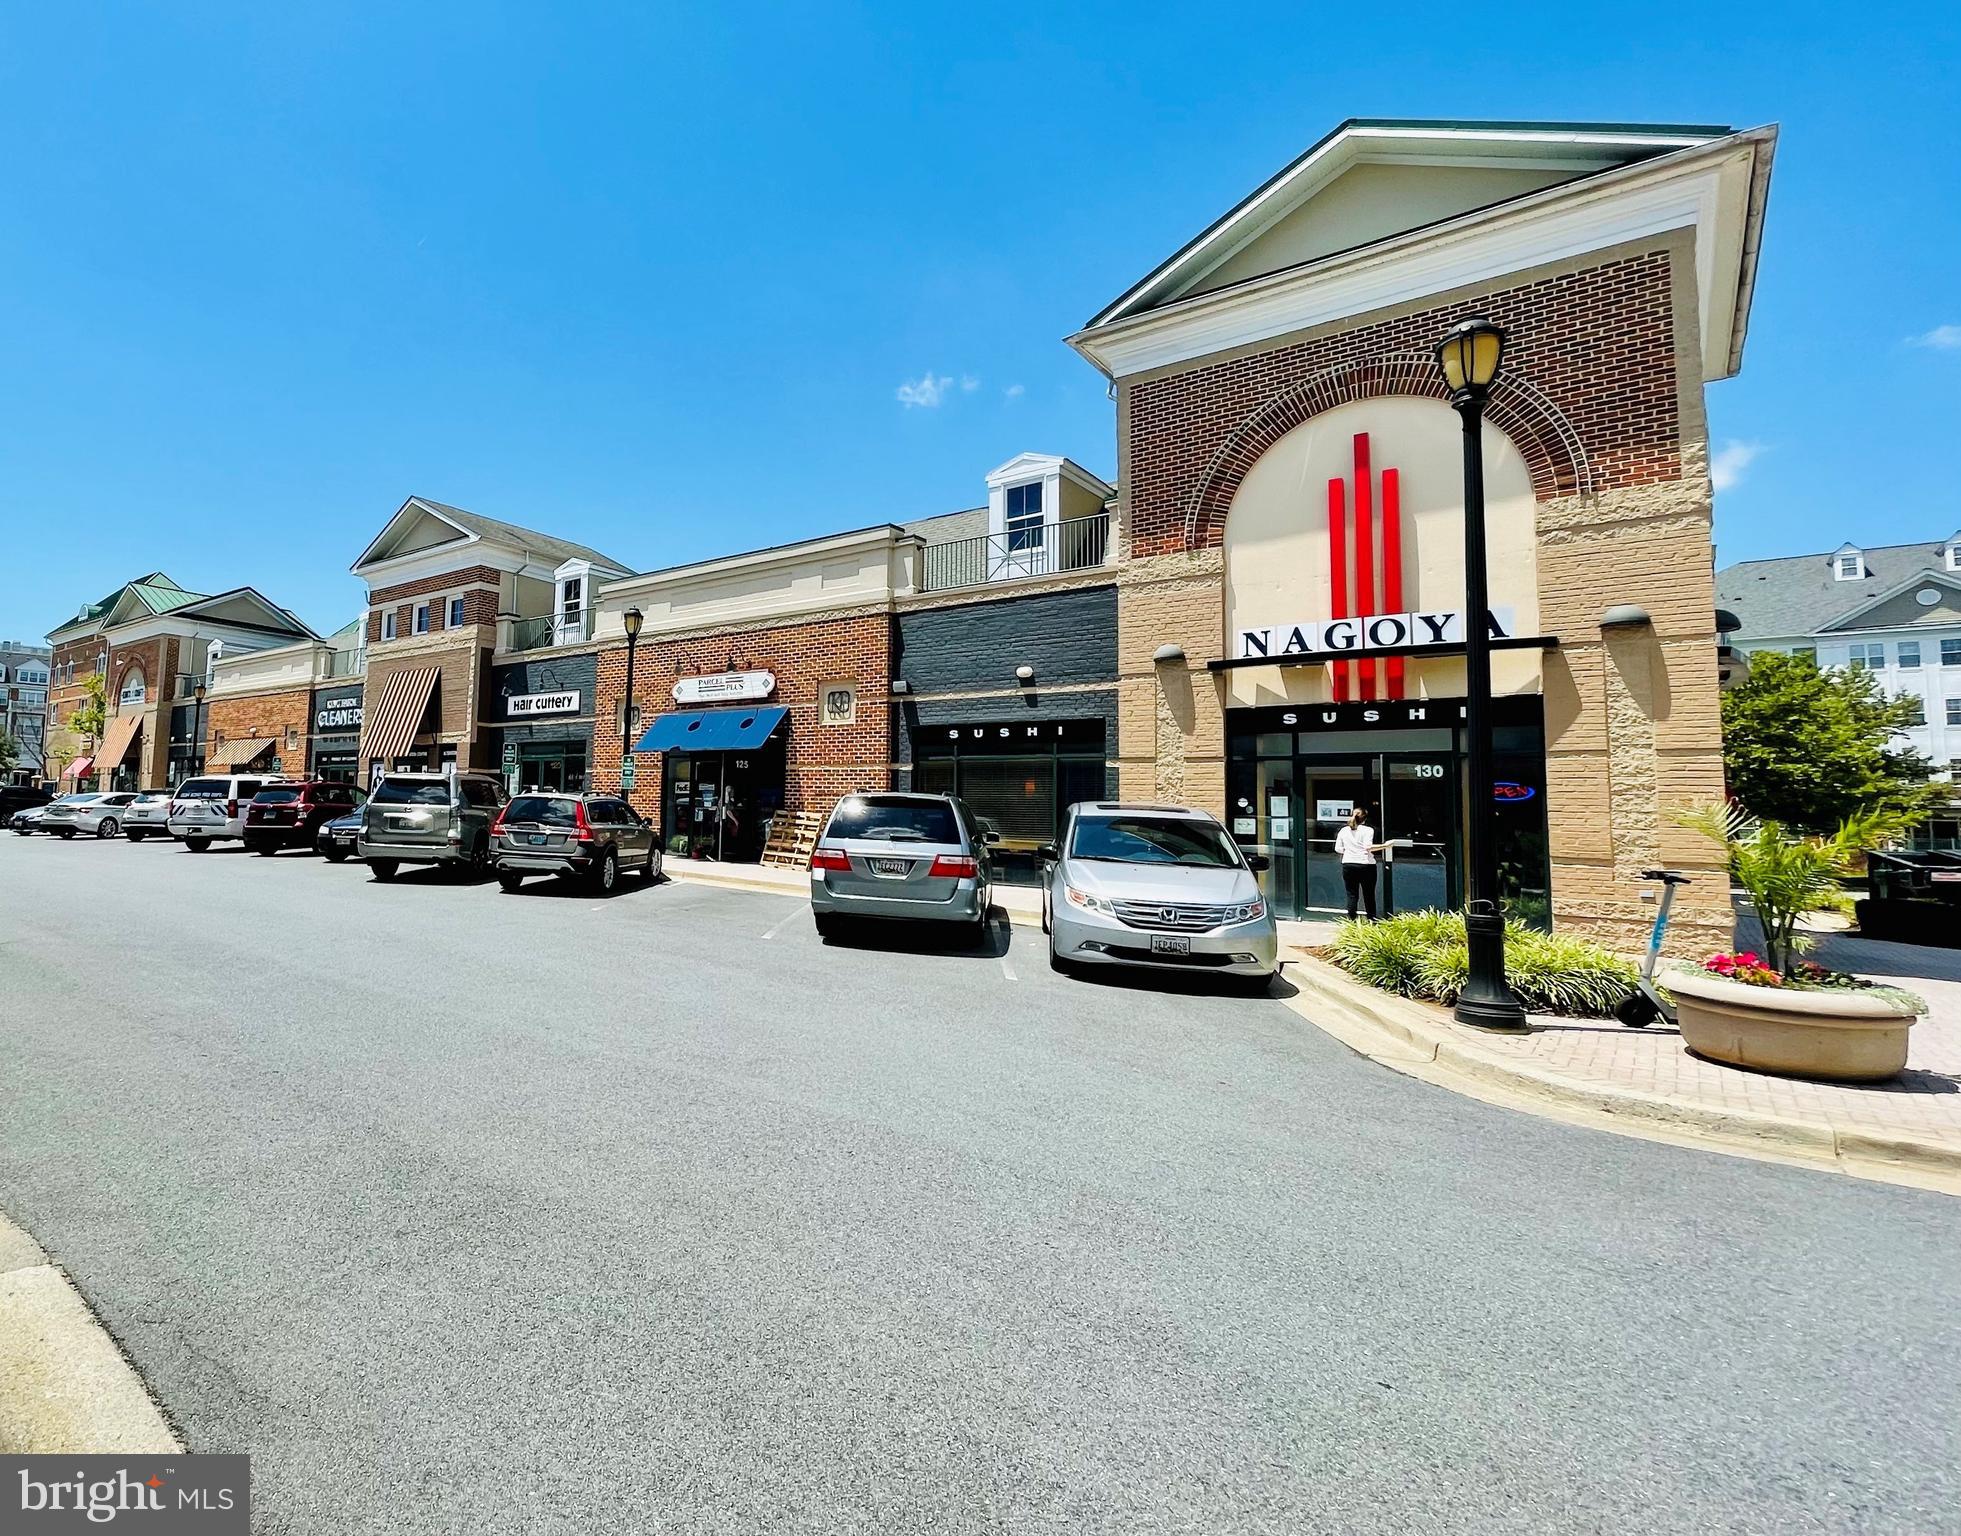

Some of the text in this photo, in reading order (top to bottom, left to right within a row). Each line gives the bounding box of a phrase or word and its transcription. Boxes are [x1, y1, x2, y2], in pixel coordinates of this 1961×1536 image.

[1242, 610, 1510, 658] NAGOYA
[698, 678, 723, 686] PARCEL
[726, 683, 744, 691] PLUS
[1282, 706, 1467, 725] SUSHI
[949, 726, 1063, 739] SUSHI
[736, 760, 749, 769] 125
[1415, 764, 1444, 778] 130
[1494, 786, 1528, 798] PEN
